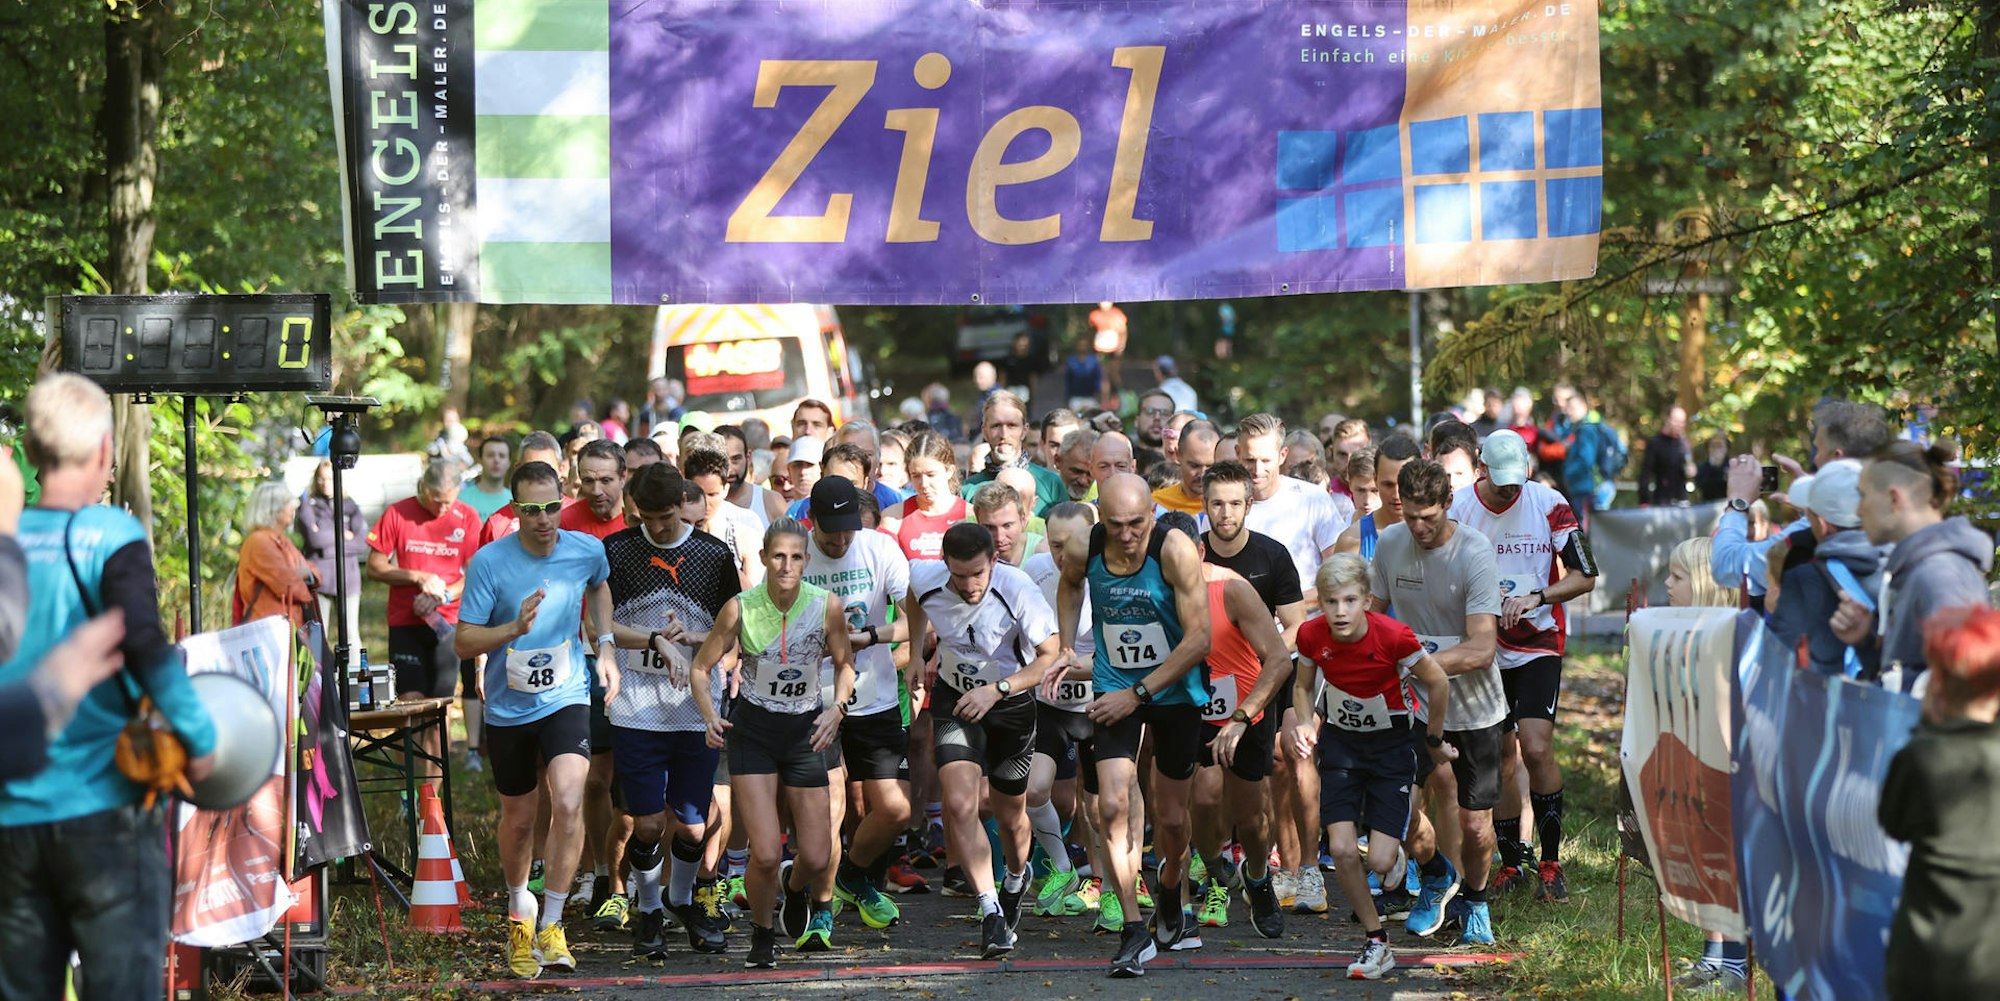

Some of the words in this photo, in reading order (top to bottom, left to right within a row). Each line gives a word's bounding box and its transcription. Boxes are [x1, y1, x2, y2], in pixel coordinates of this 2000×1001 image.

[1301, 48, 1374, 63] Einfach
[1388, 49, 1430, 63] eine
[368, 1, 425, 291] ENGELS
[725, 46, 1167, 245] Ziel
[1497, 543, 1551, 554] BASTIAN
[1110, 587, 1151, 598] REFRATH
[1116, 645, 1157, 663] 174
[527, 668, 554, 687] 48
[768, 681, 807, 697] 148
[1337, 708, 1377, 728] 254
